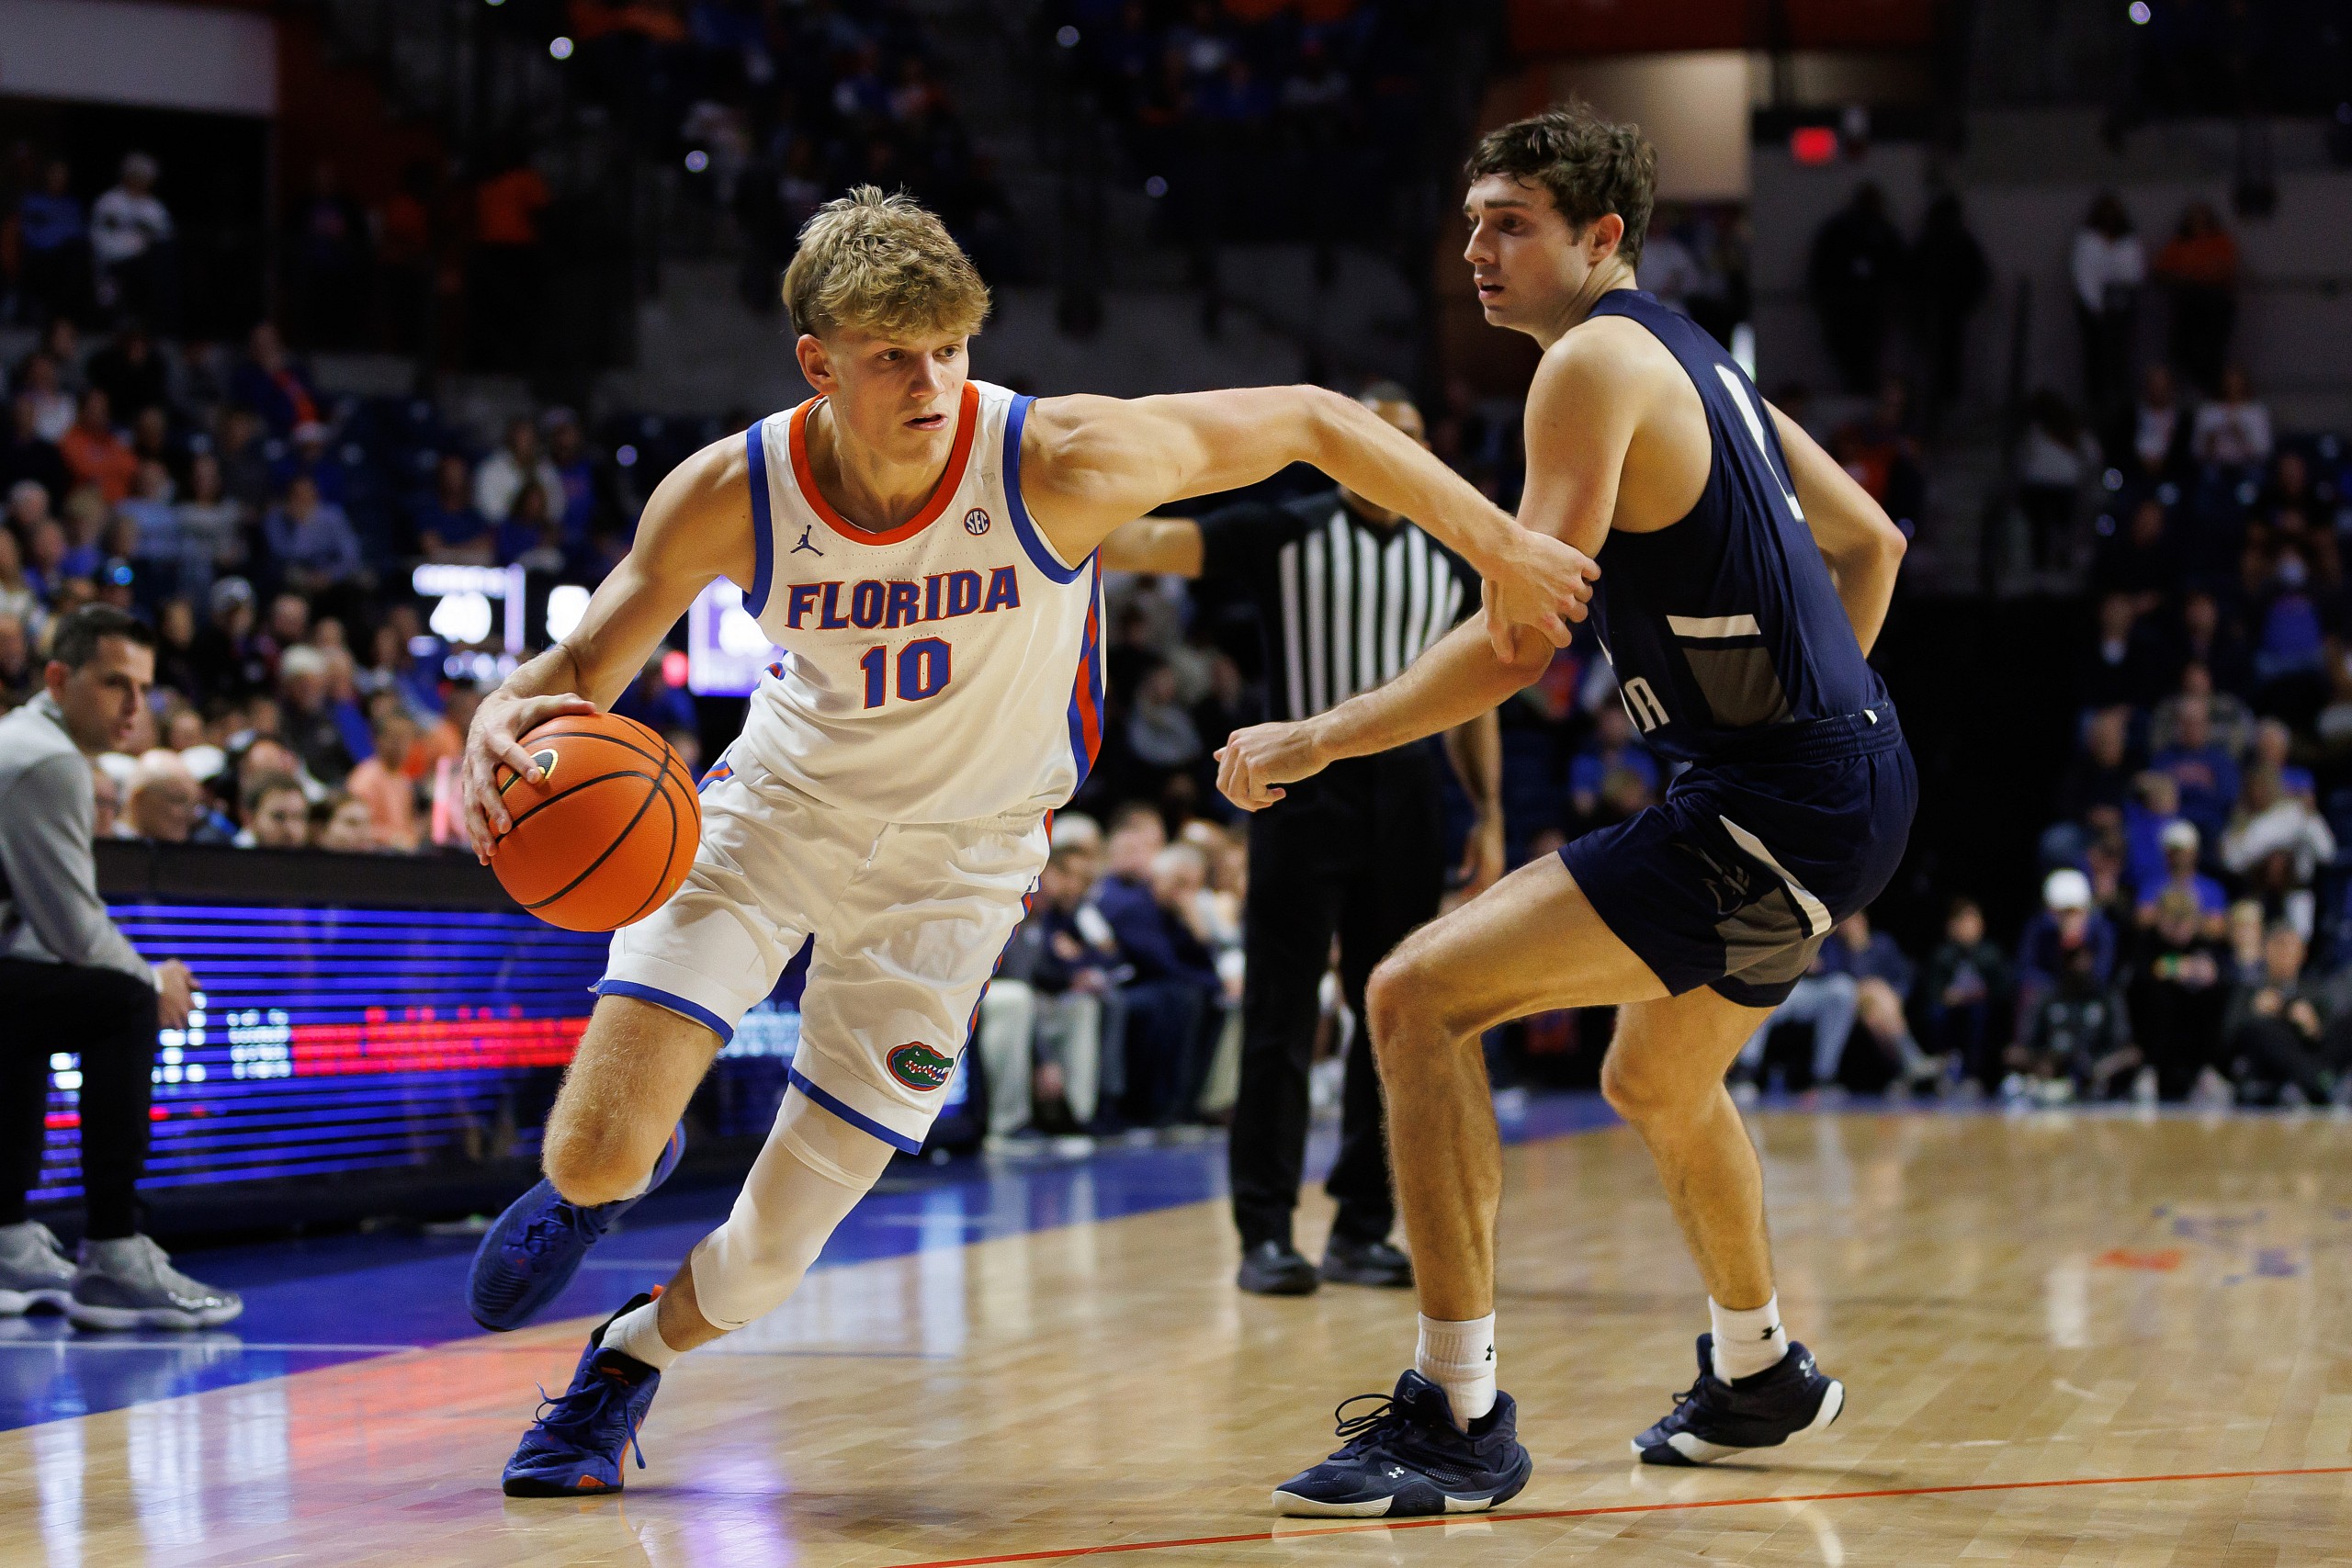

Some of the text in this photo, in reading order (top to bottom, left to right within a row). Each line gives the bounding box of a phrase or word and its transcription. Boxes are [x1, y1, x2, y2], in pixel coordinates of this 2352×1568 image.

[966, 511, 989, 534] SEC
[785, 565, 1021, 630] FLORIDA
[860, 637, 951, 709] 10
